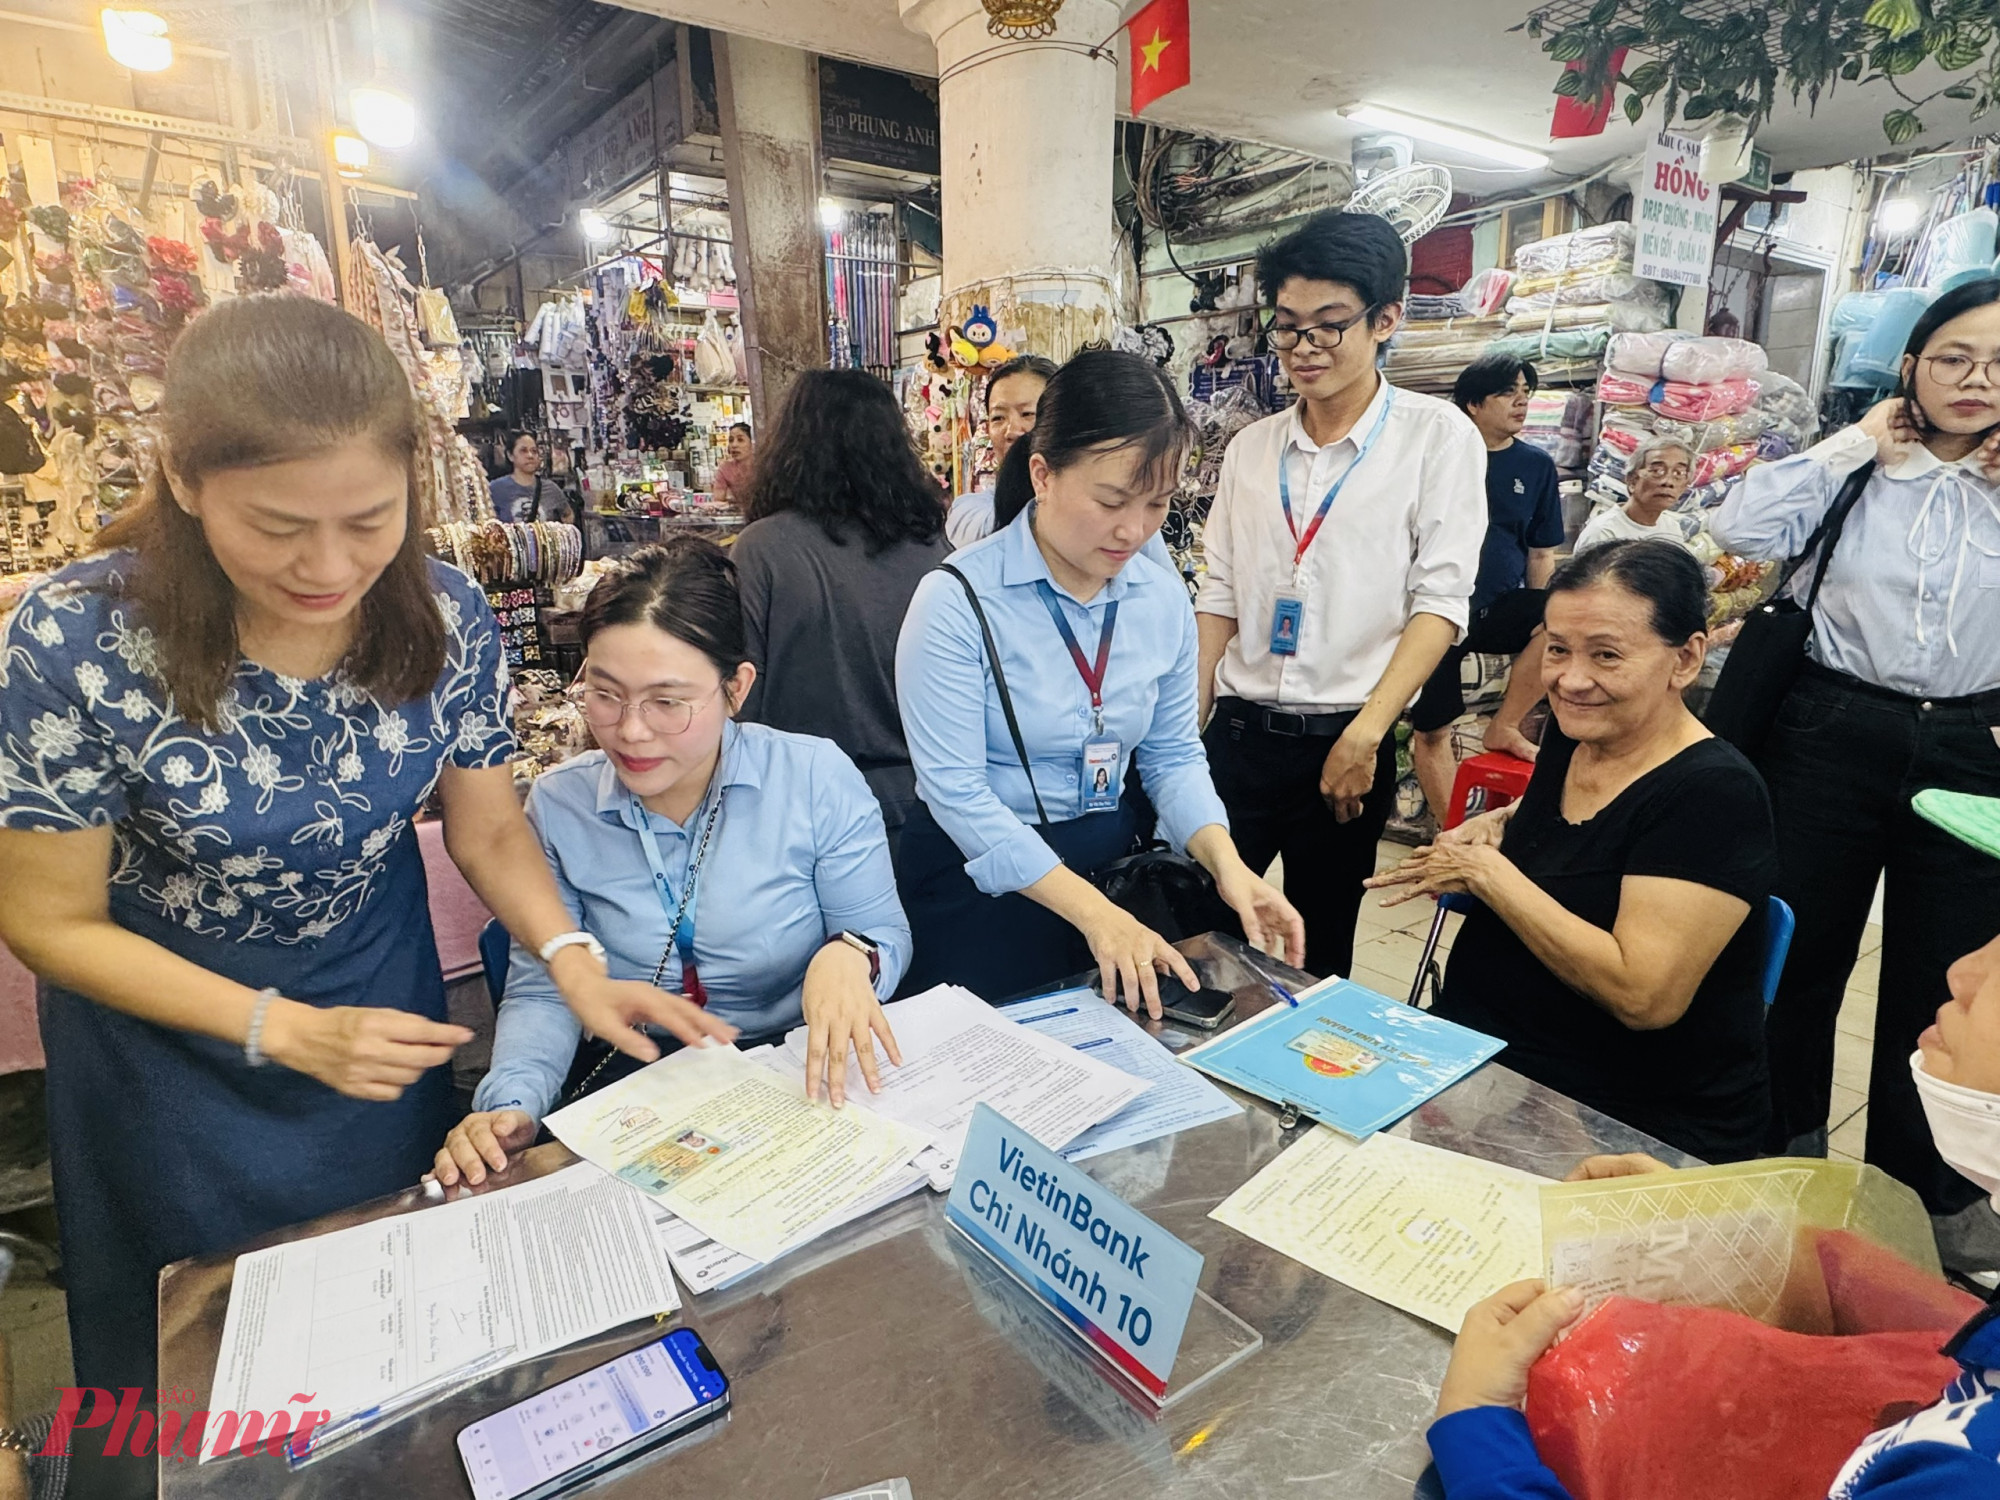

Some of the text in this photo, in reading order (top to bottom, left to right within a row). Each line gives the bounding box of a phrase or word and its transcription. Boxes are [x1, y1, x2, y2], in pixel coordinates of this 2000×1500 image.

[904, 125, 936, 148] ANH
[1654, 155, 1710, 202] HỒNG
[1642, 198, 1663, 223] DRAP
[999, 1137, 1150, 1280] VietinBank
[969, 1179, 1152, 1347] Chi Nhánh 10
